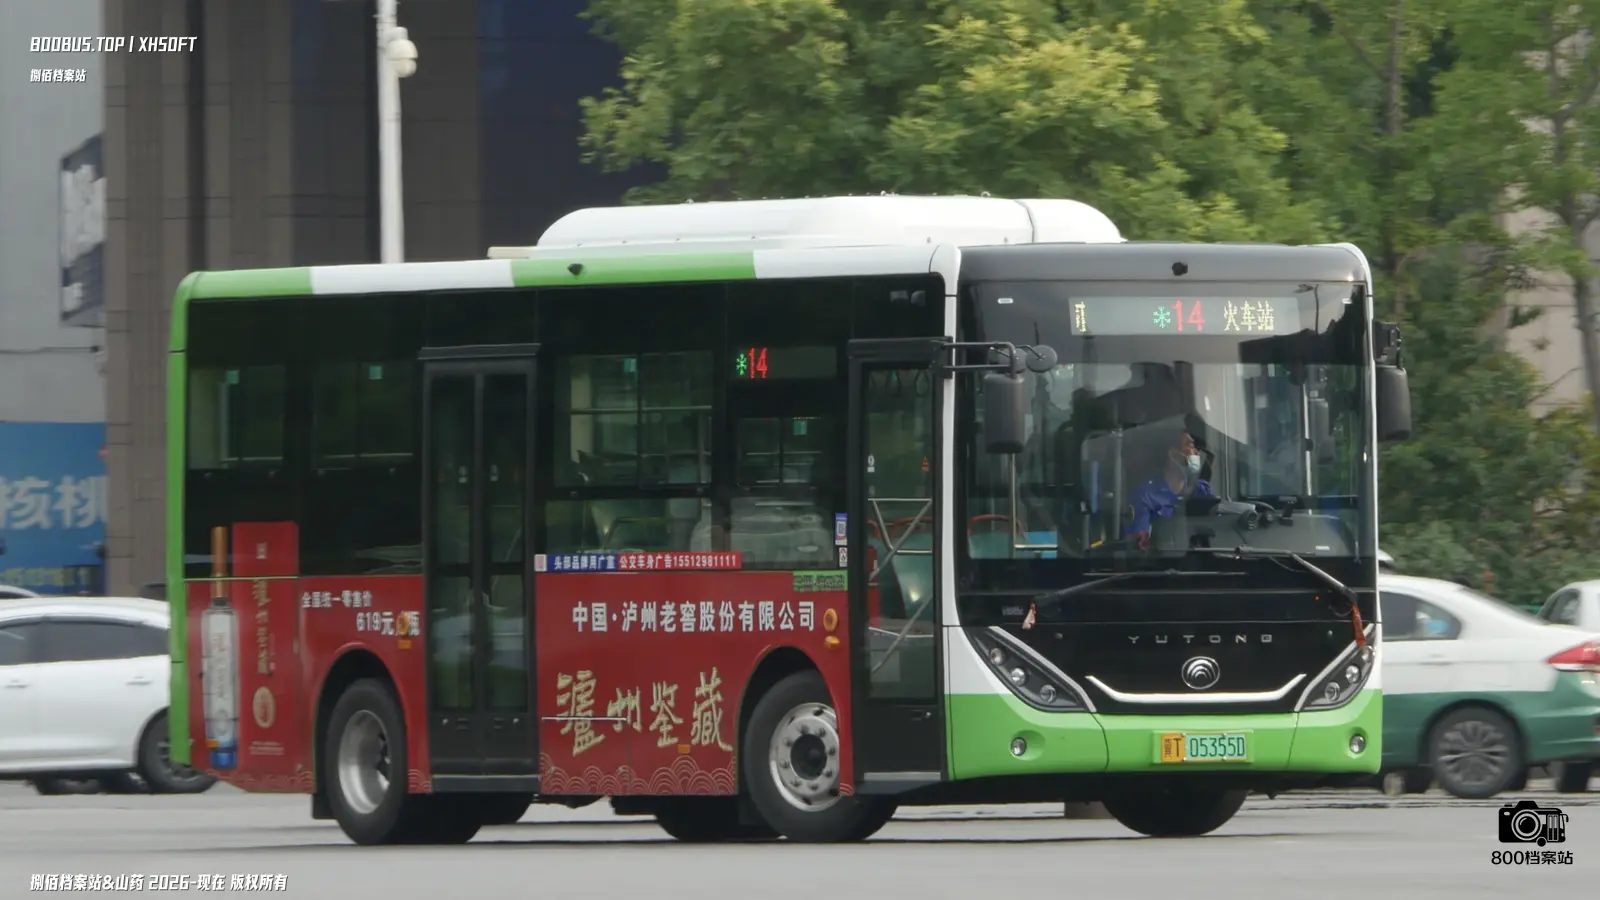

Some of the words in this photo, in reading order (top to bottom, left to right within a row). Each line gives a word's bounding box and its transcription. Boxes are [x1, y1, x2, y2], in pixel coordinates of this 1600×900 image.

[1172, 300, 1205, 332] 14
[1223, 301, 1274, 332] 火车站
[748, 347, 768, 379] 14
[1128, 634, 1273, 644] YUTONG
